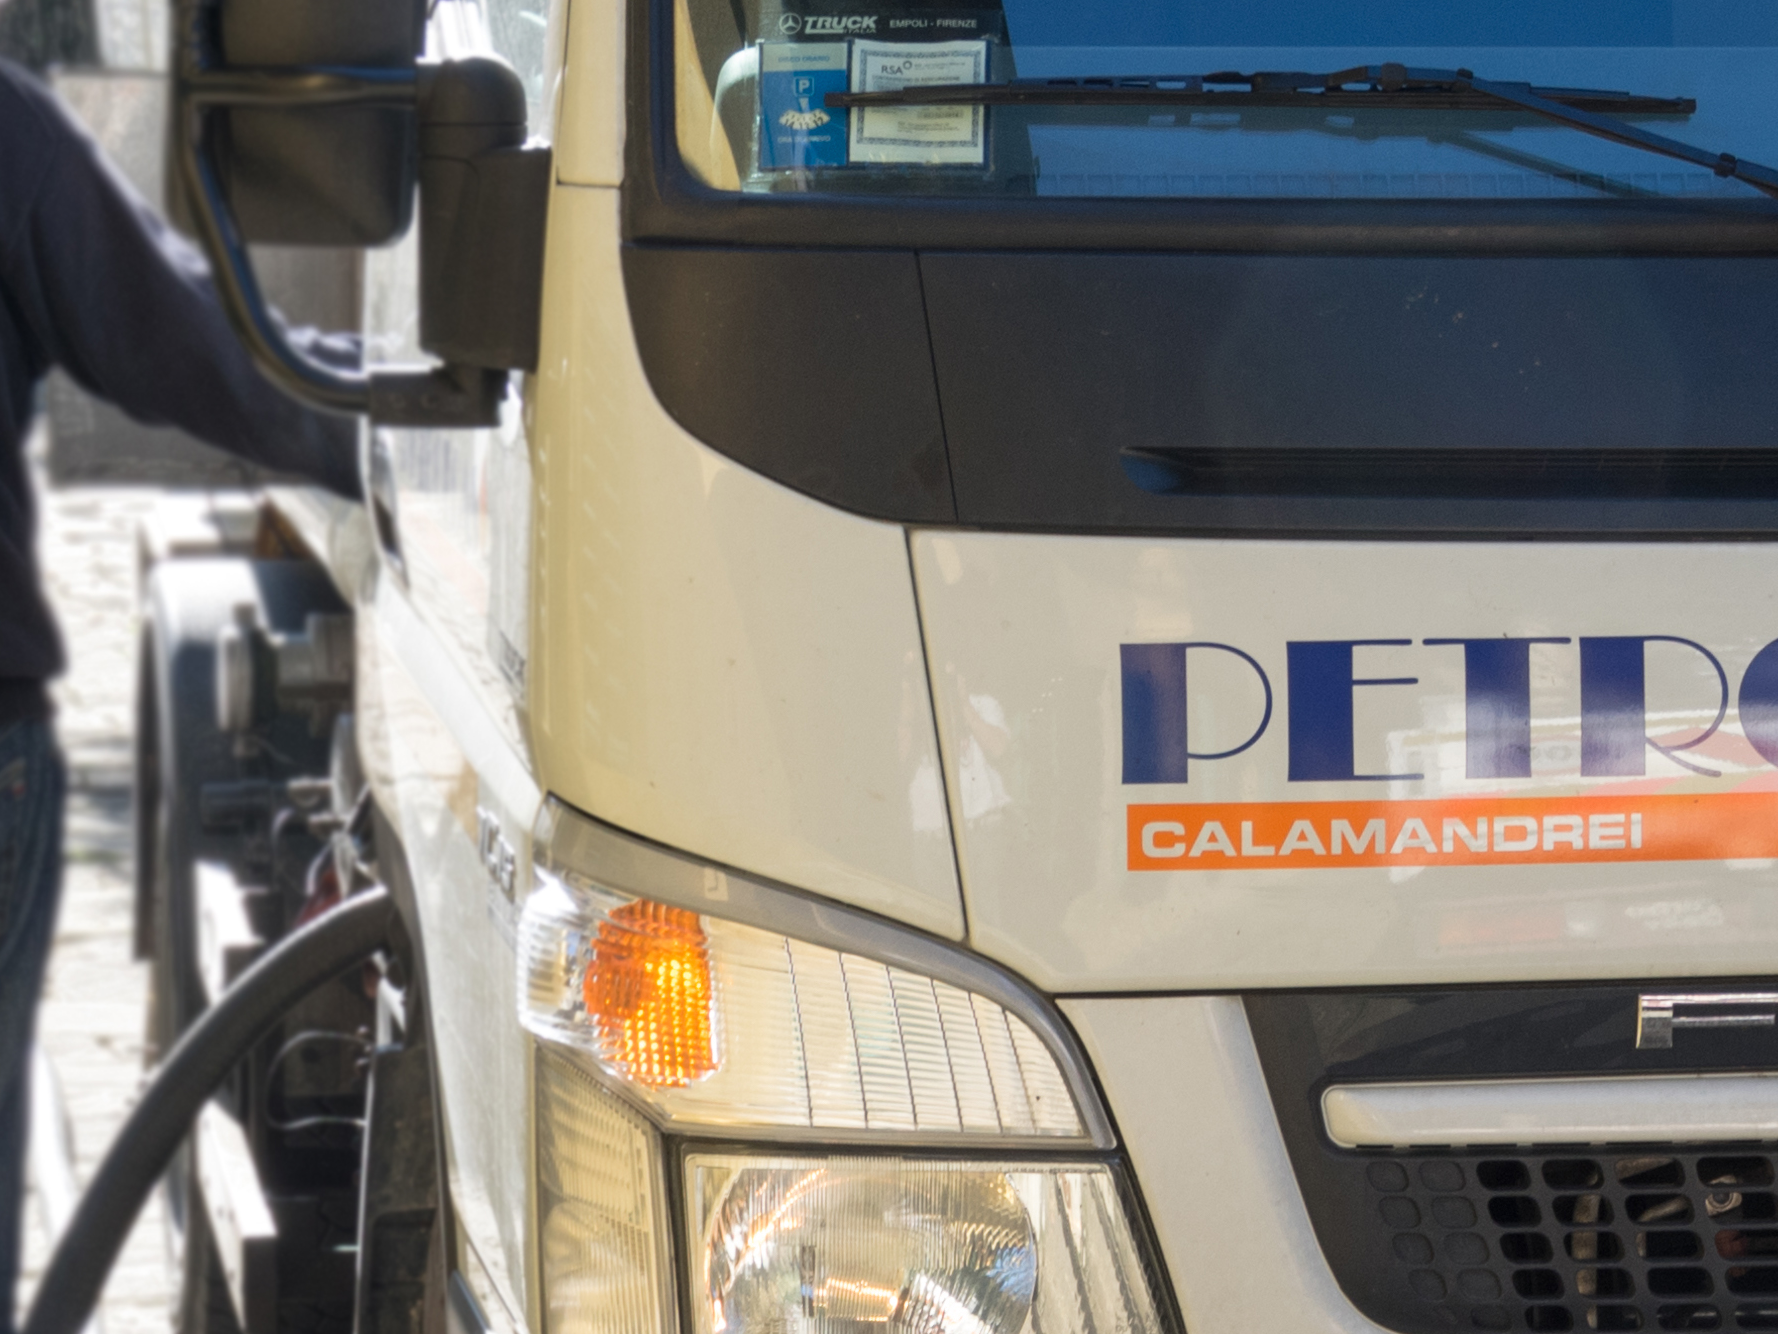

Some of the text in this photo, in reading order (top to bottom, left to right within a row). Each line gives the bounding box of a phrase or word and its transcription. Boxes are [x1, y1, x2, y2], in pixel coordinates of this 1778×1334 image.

[804, 15, 879, 35] TRUCK
[889, 18, 928, 29] EMPOLI
[936, 18, 978, 29] FIRENZE
[881, 64, 903, 76] RSA
[798, 80, 810, 93] P
[1140, 811, 1644, 859] CALAMANDREI
